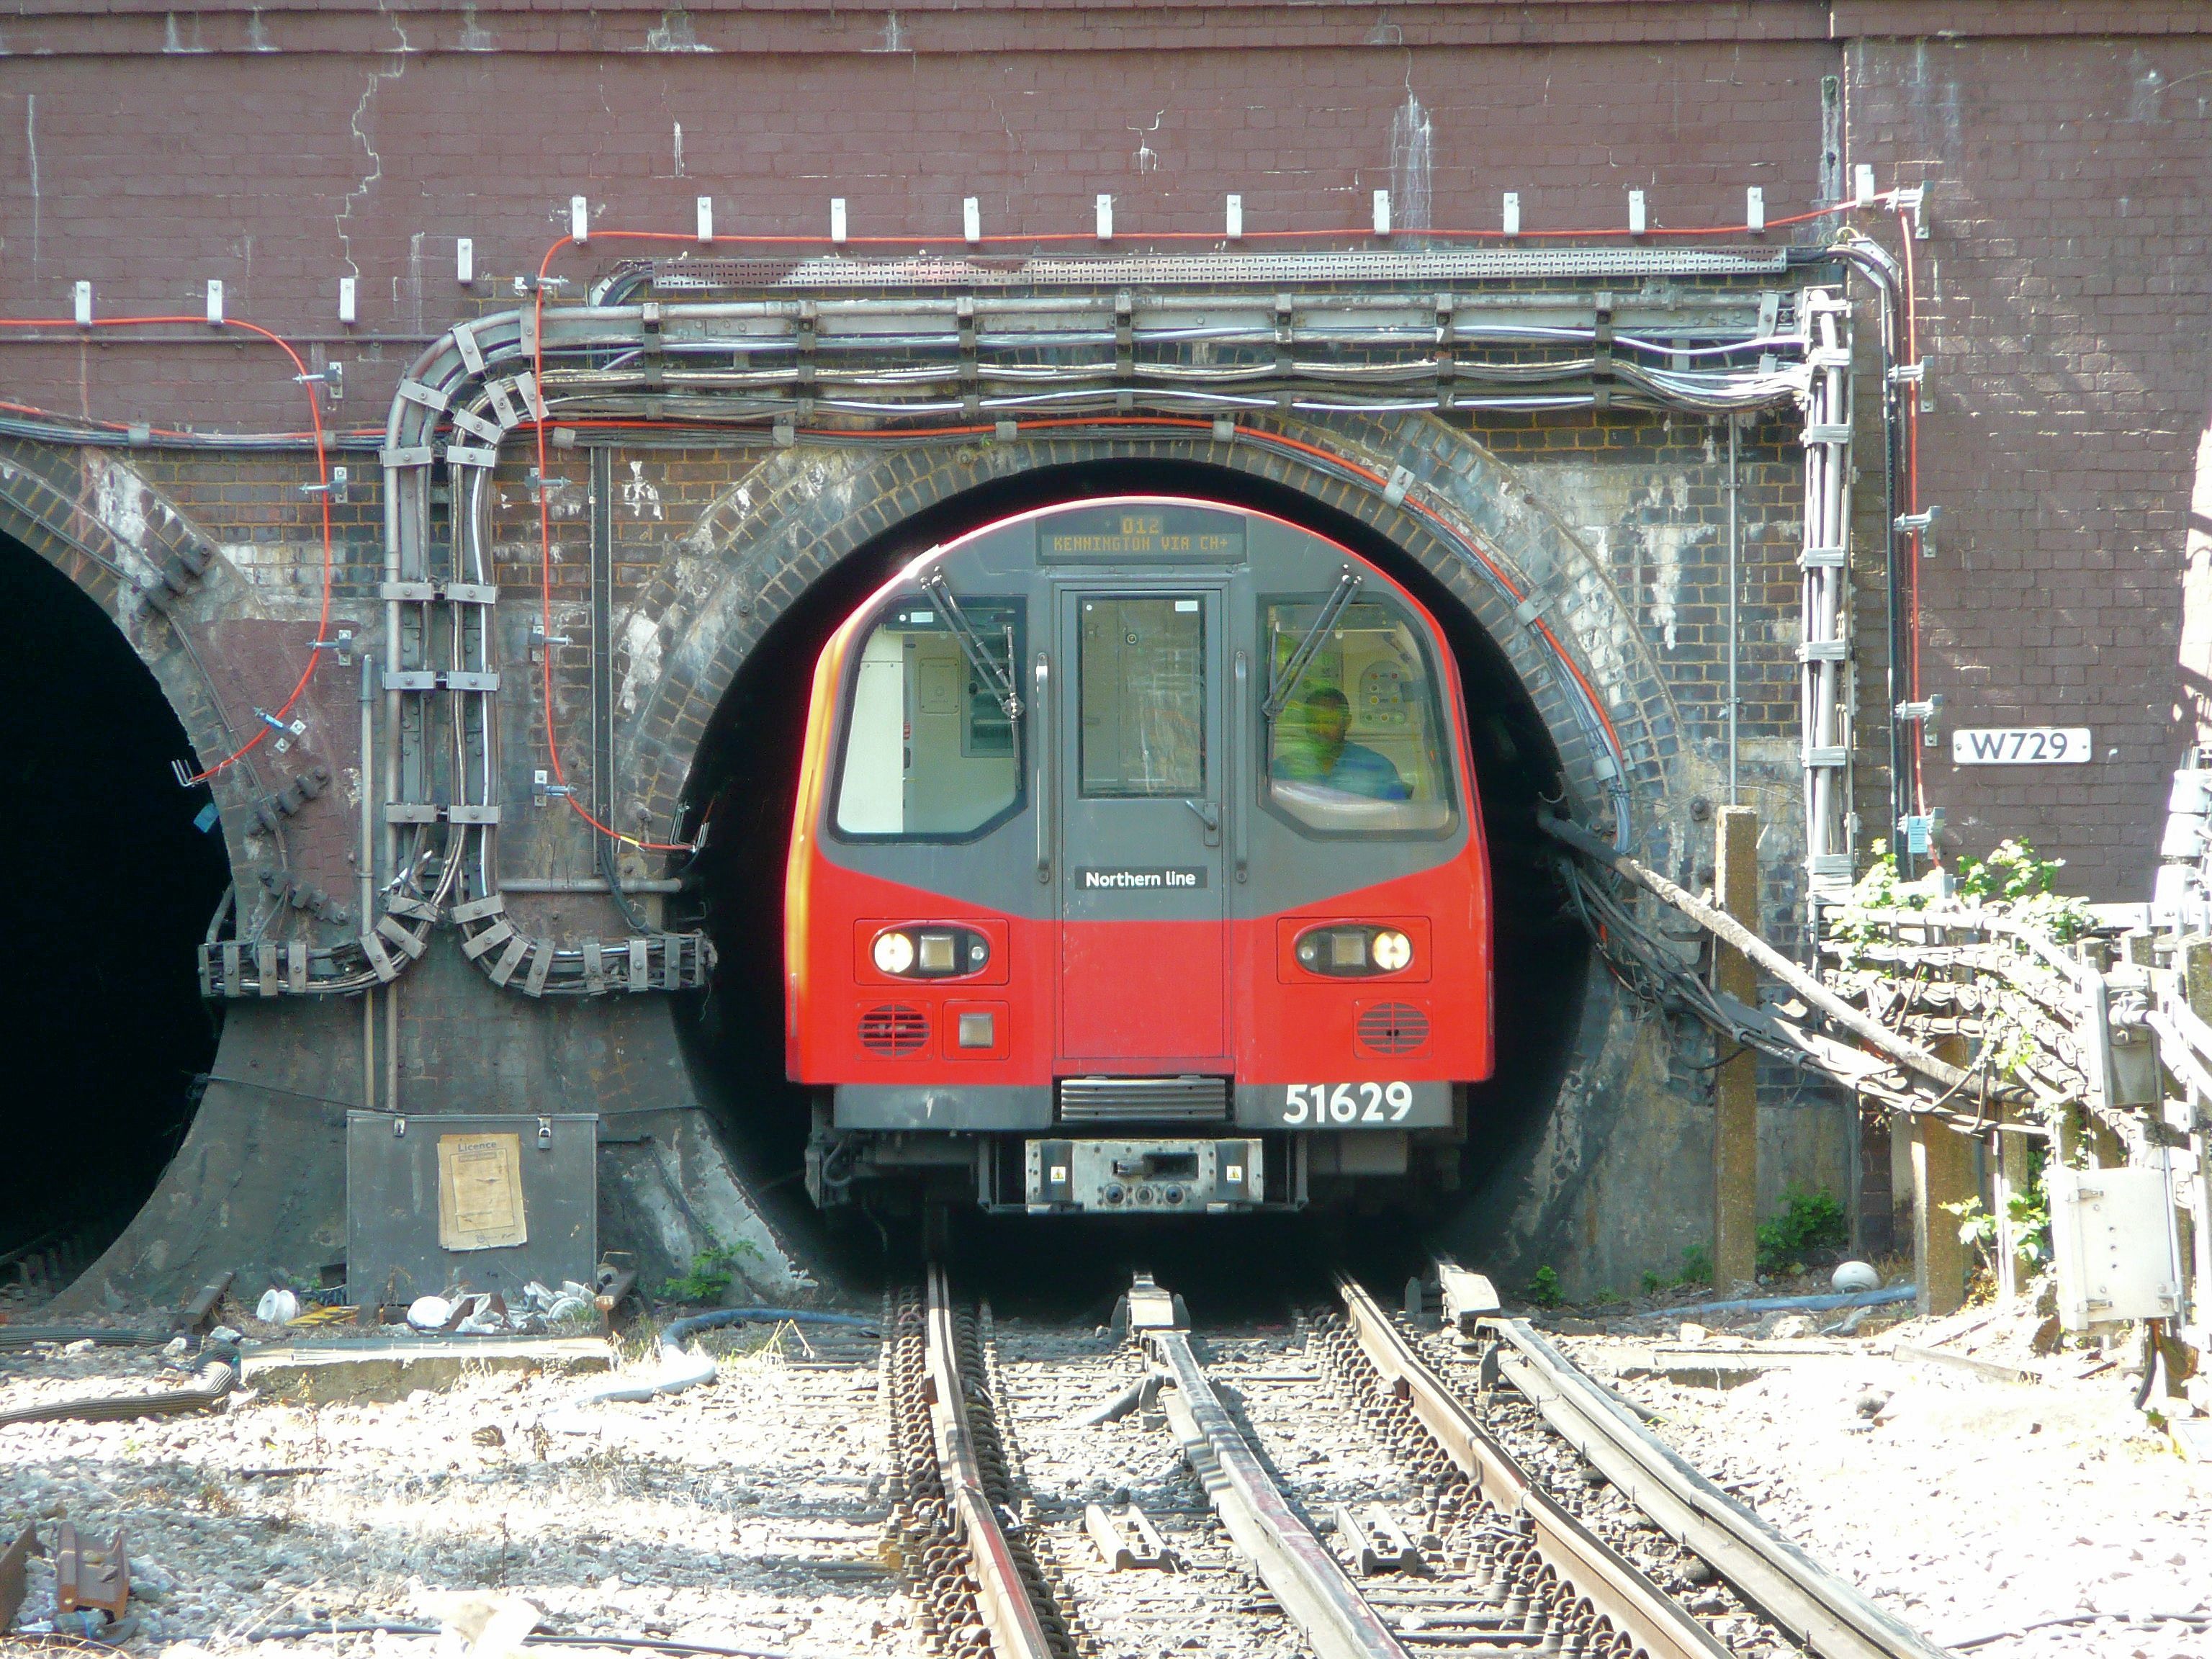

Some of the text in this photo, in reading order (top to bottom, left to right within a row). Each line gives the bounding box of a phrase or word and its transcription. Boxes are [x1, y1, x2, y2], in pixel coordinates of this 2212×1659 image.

[1054, 536, 1150, 551] KENNINGTON
[1161, 536, 1190, 550] VIA
[1970, 732, 2068, 760] W729
[1086, 871, 1196, 887] Northern line
[1282, 1081, 1413, 1123] 51629
[458, 1141, 497, 1152] Licence
